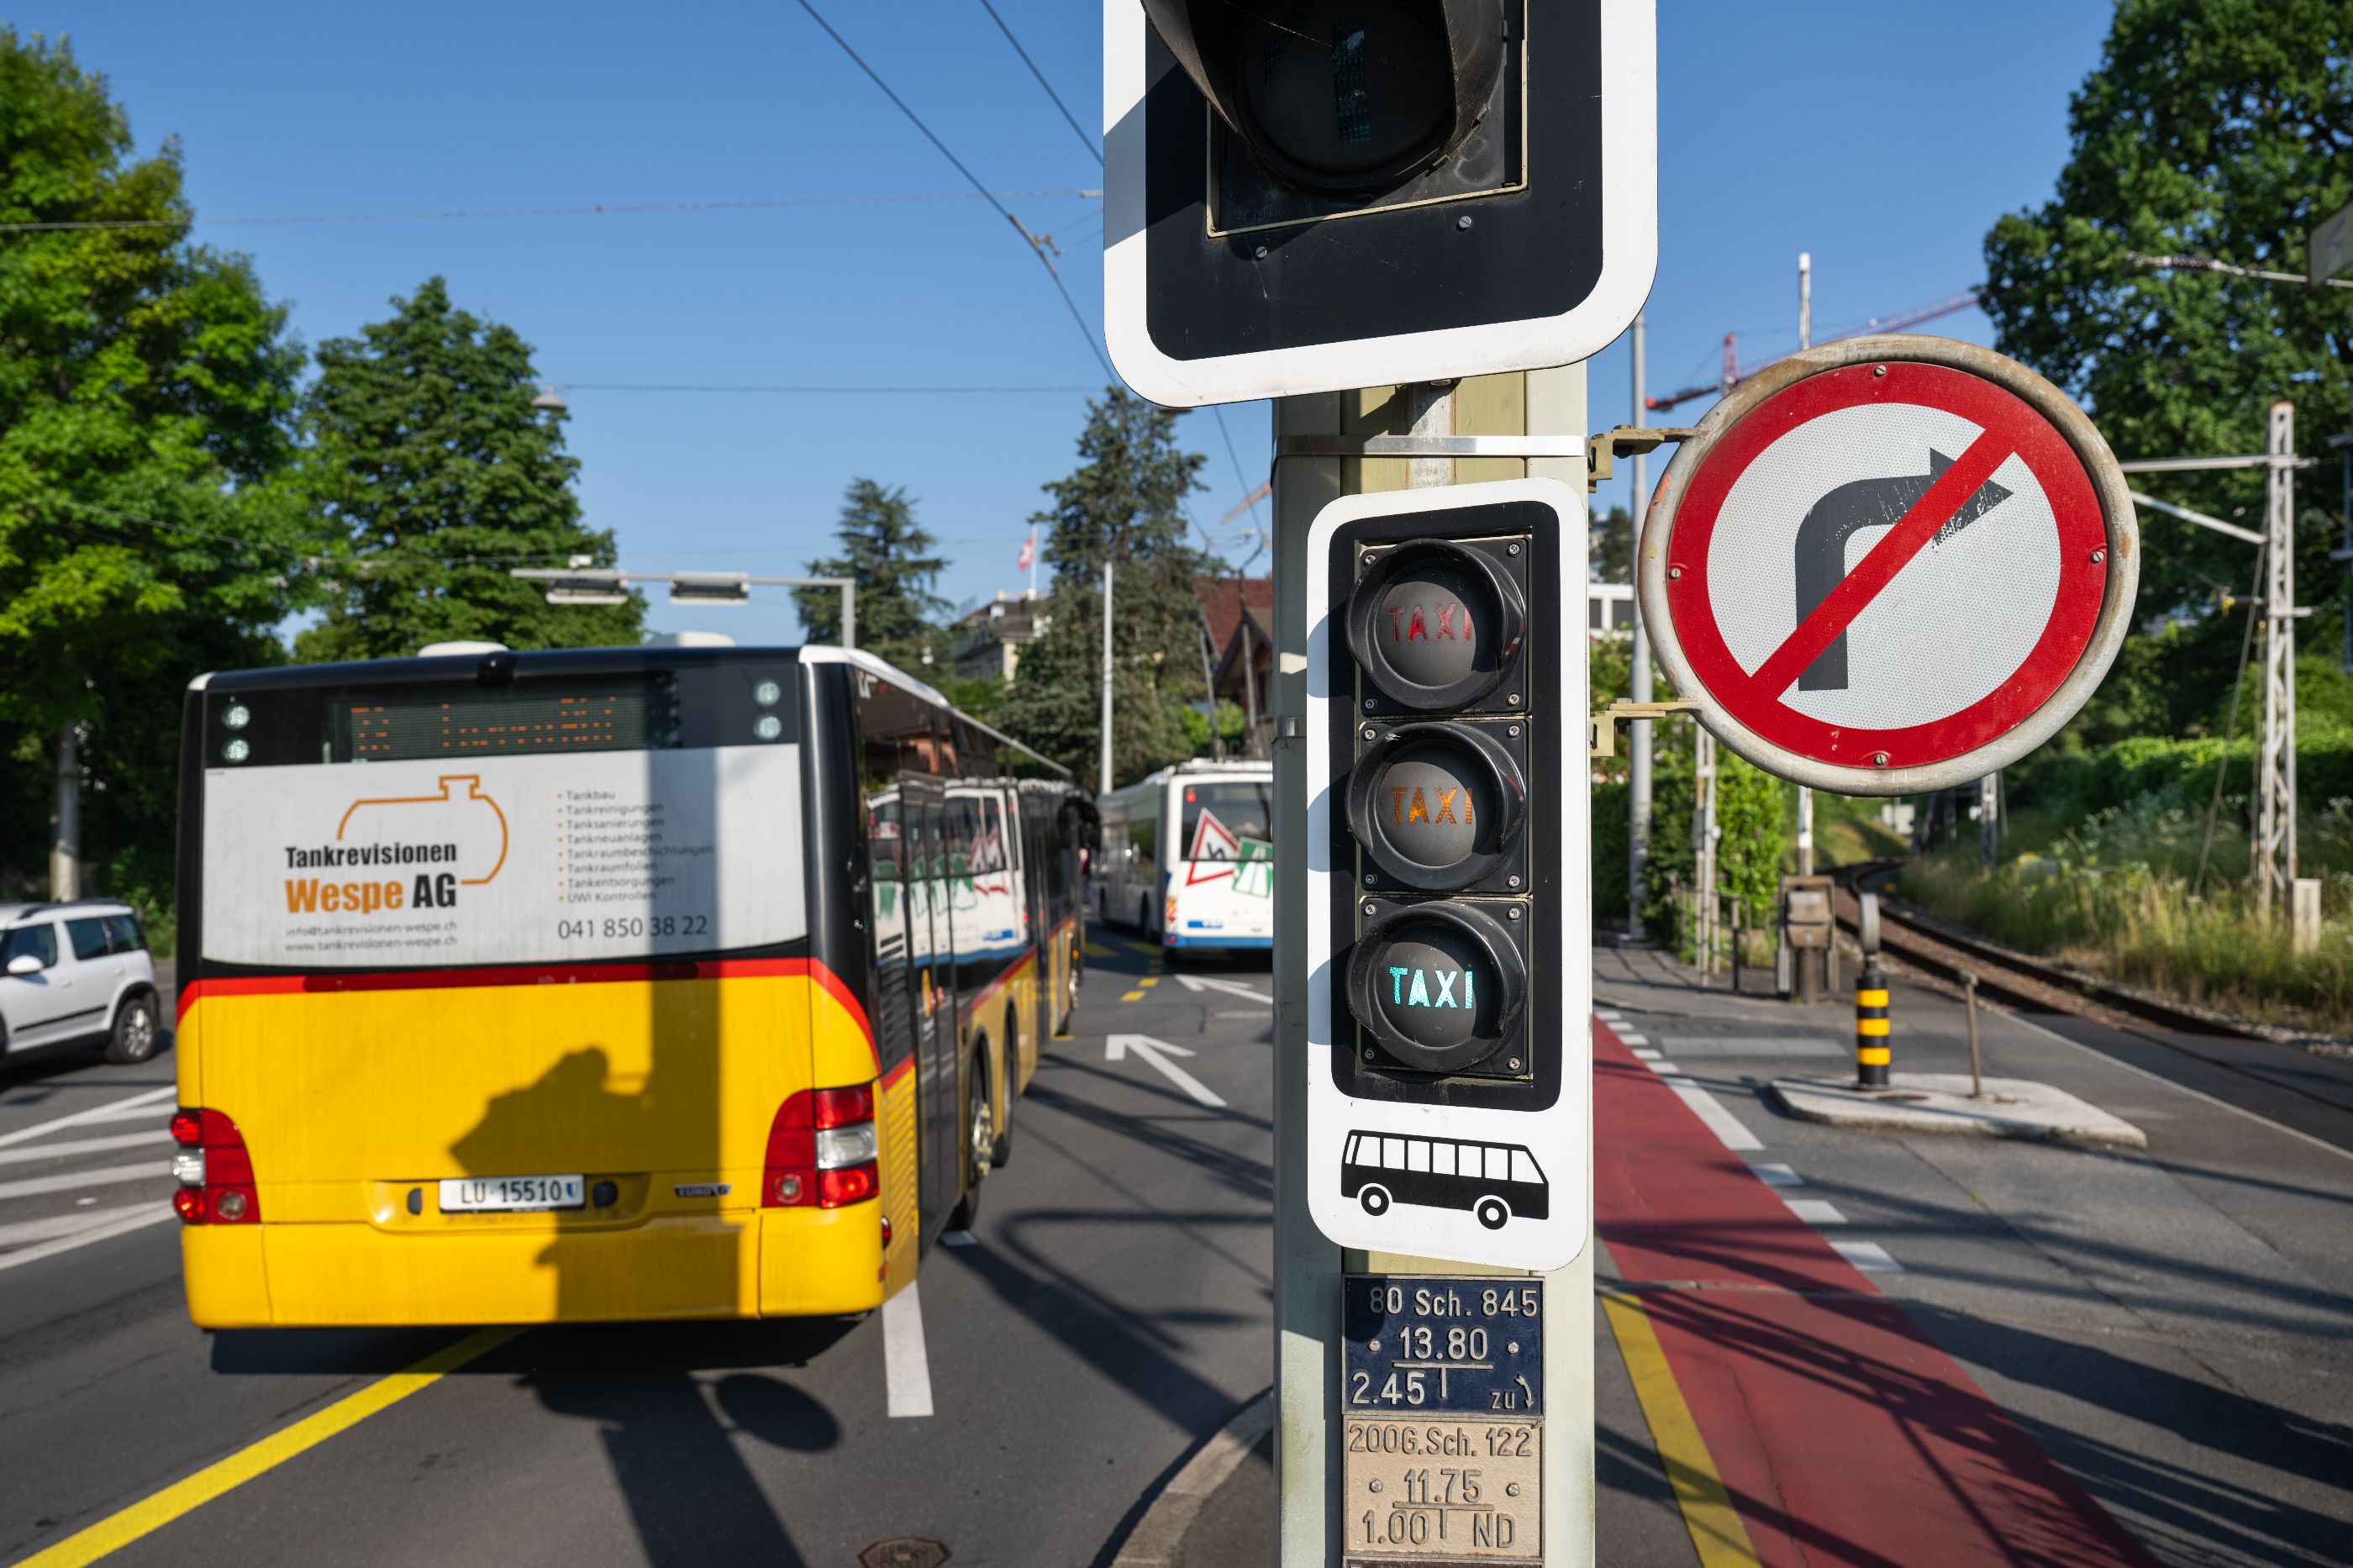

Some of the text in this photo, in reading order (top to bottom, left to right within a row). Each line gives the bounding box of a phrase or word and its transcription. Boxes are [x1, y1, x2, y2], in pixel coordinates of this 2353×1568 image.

[1387, 602, 1472, 645] TAXI
[566, 790, 615, 801] Tankbau
[1389, 786, 1473, 825] TAXI
[285, 842, 457, 868] Tankrevisionen
[285, 872, 457, 914] Wespe AG
[558, 915, 708, 939] 041 850 38 22
[1389, 966, 1473, 1009] TAXI
[500, 1180, 561, 1202] 15510
[1370, 1286, 1538, 1317] 80 Sch. 845
[1398, 1326, 1488, 1360] 13.80
[1351, 1371, 1426, 1405] 2.45
[1486, 1427, 1534, 1457] 122
[1403, 1468, 1483, 1503] 11.75
[1362, 1509, 1516, 1548] 1.00 ND
